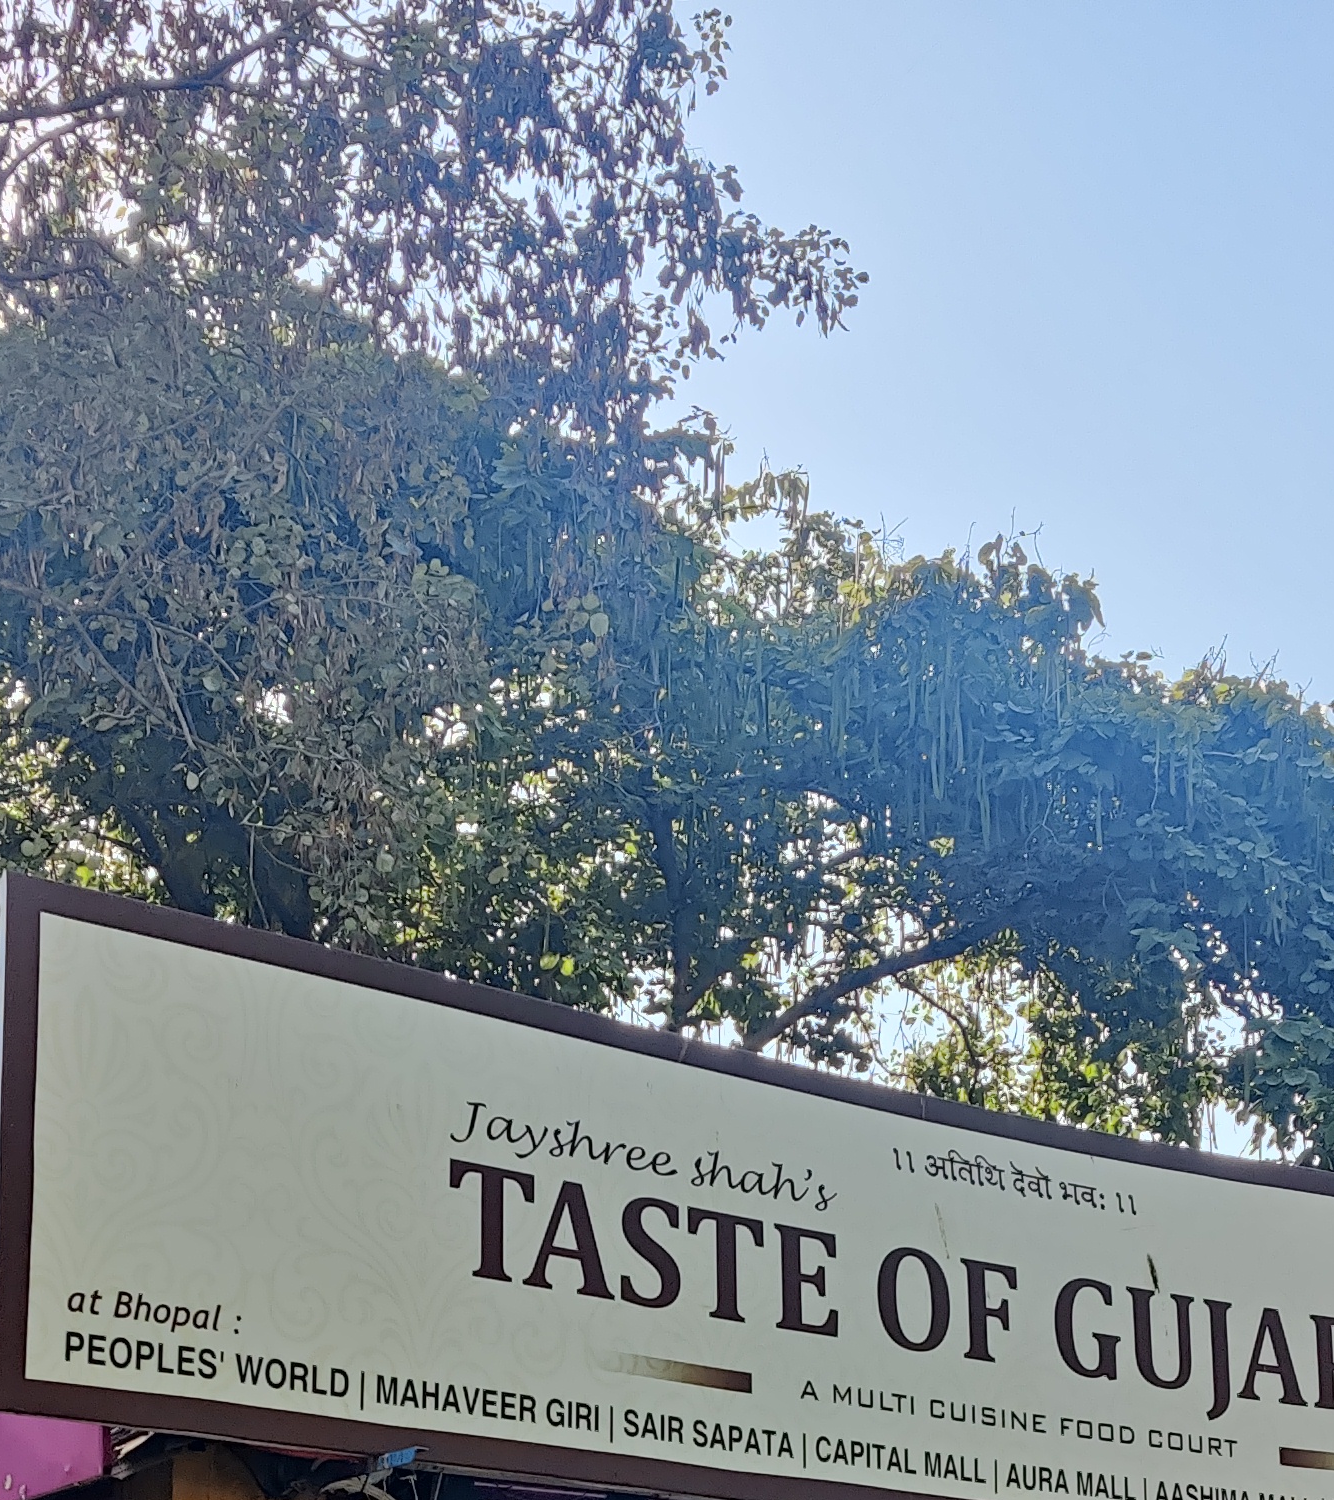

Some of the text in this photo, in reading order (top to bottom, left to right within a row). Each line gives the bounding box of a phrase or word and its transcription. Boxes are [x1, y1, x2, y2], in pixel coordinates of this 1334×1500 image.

[449, 1101, 679, 1176] Jayshree
[925, 1150, 1005, 1191] अतिथि
[1010, 1161, 1053, 1200] देवो
[449, 1158, 839, 1337] TASTE
[877, 1246, 1018, 1364] OF
[67, 1290, 102, 1315] at
[65, 1331, 224, 1380] PEOPLES'
[236, 1353, 349, 1398] WORLD
[376, 1374, 536, 1423] MAHAVEER
[546, 1398, 599, 1432] GIRI
[623, 1410, 683, 1444] SAIR
[692, 1420, 794, 1459] SAPATA
[815, 1436, 917, 1475] CAPITAL
[925, 1452, 987, 1484] MALL
[1006, 1462, 1069, 1494] AURA
[801, 1380, 1238, 1458] A MULTI CUISINE FOOD COURT
